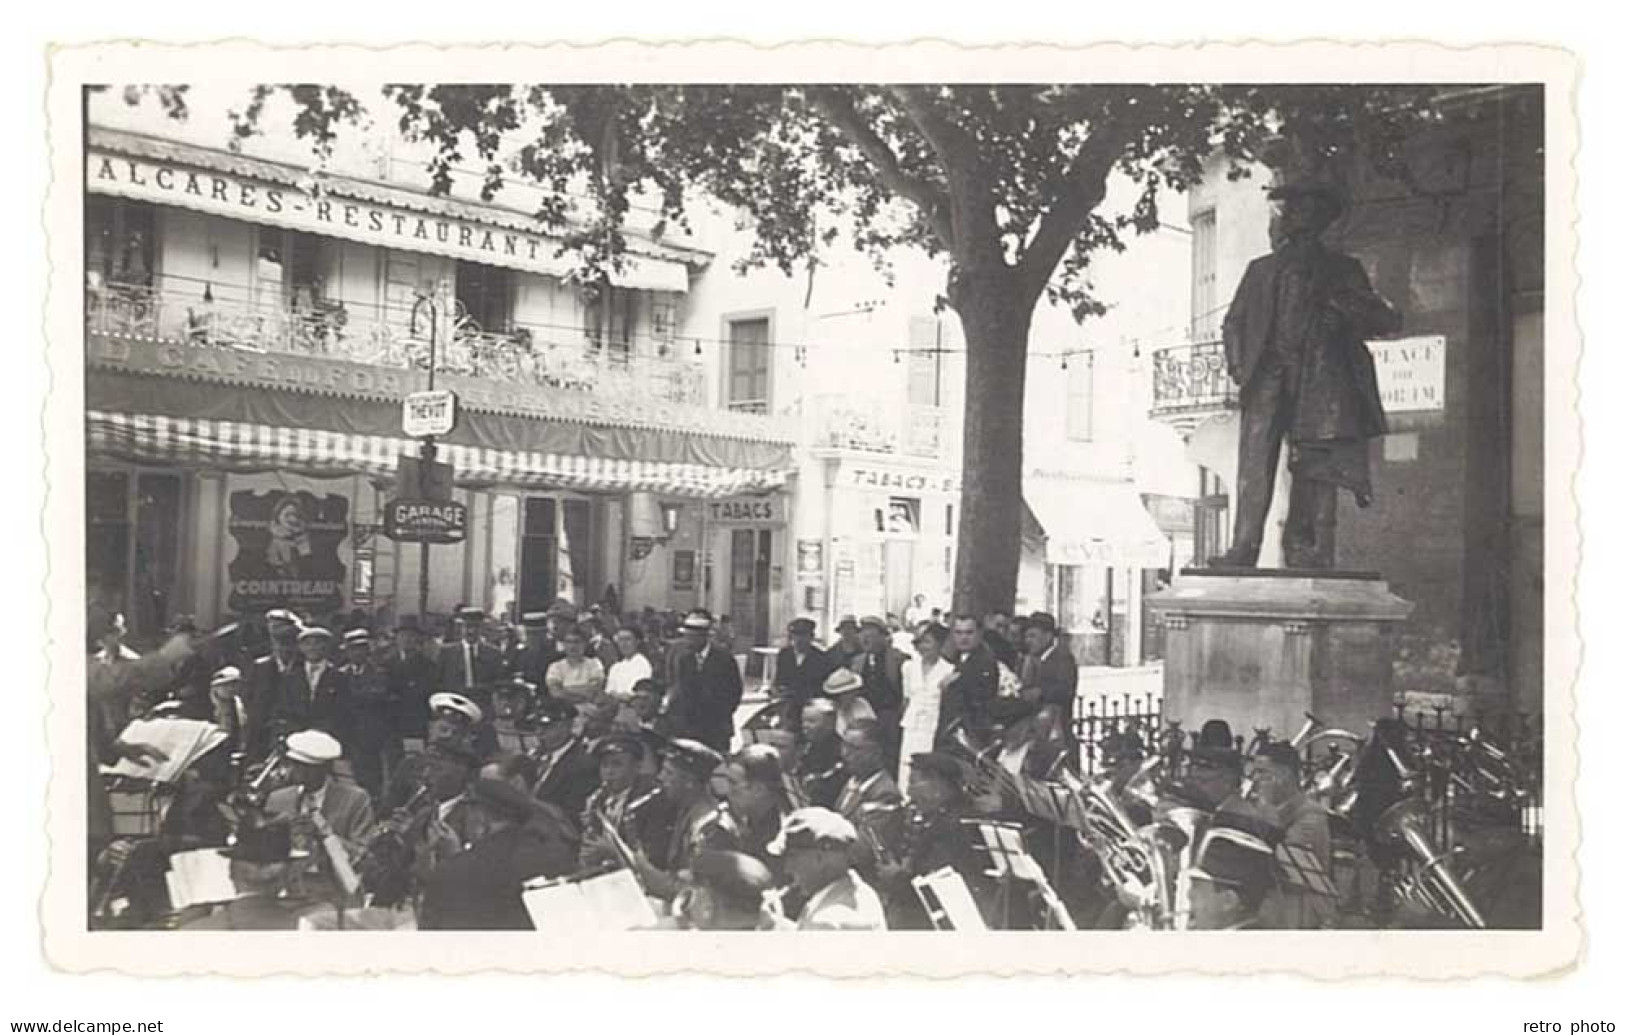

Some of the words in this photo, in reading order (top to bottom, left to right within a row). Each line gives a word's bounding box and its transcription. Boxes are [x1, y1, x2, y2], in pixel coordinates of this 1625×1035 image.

[1382, 385, 1435, 402] ORUM
[396, 505, 463, 526] GARAGE
[712, 501, 773, 520] TABACS
[236, 580, 335, 595] COINTREAU
